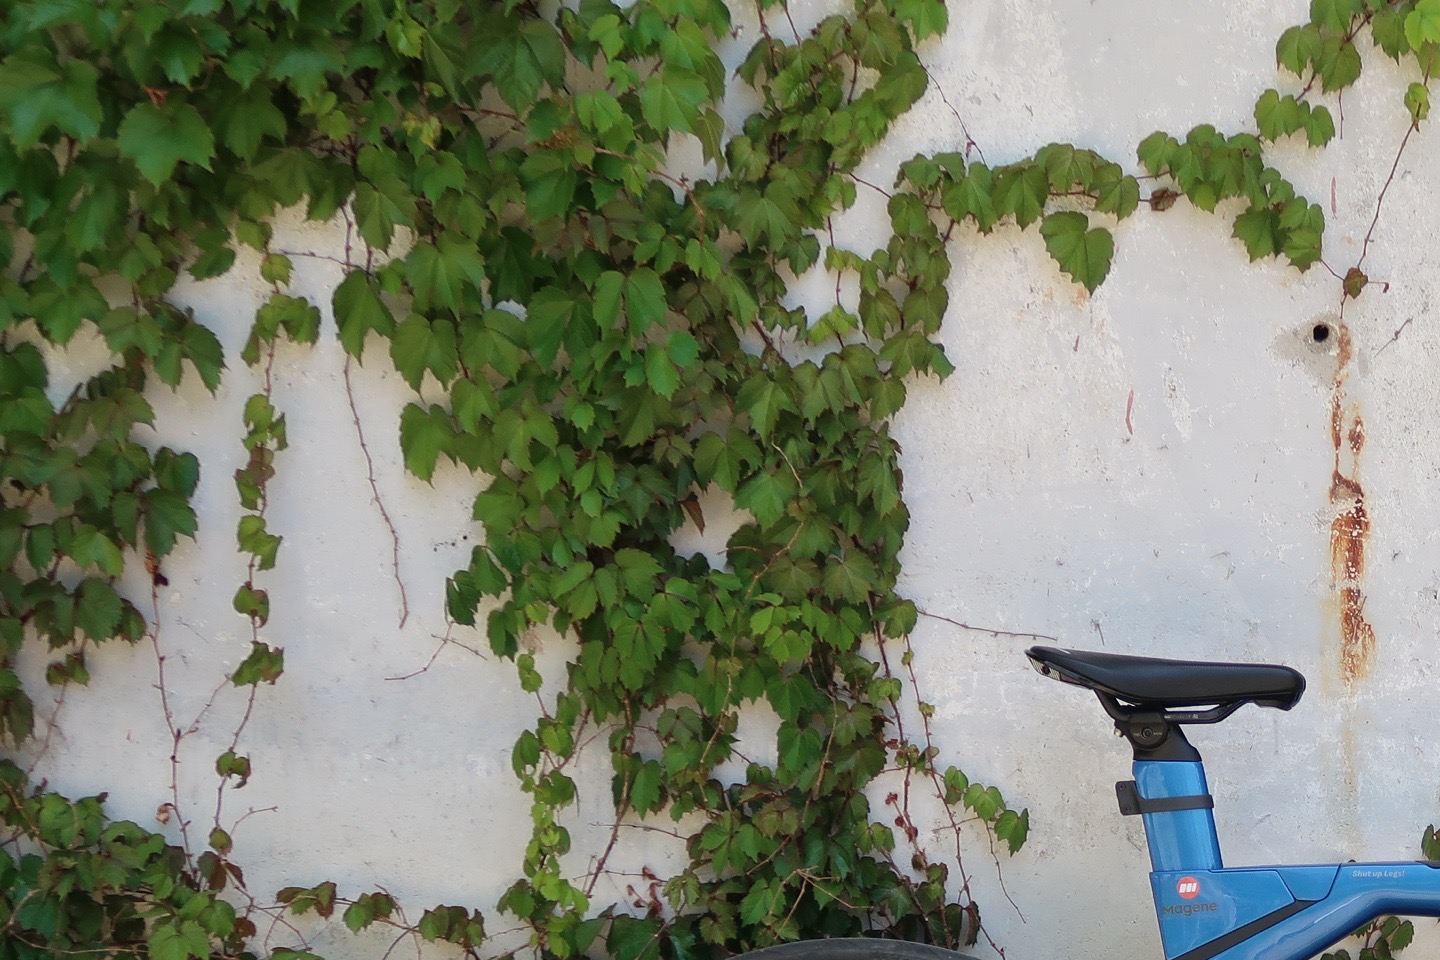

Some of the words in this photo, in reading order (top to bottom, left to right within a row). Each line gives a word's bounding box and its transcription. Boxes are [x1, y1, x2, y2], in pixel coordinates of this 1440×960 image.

[1352, 870, 1372, 878] Shut
[1373, 871, 1383, 879] up
[1163, 902, 1218, 916] Magene
